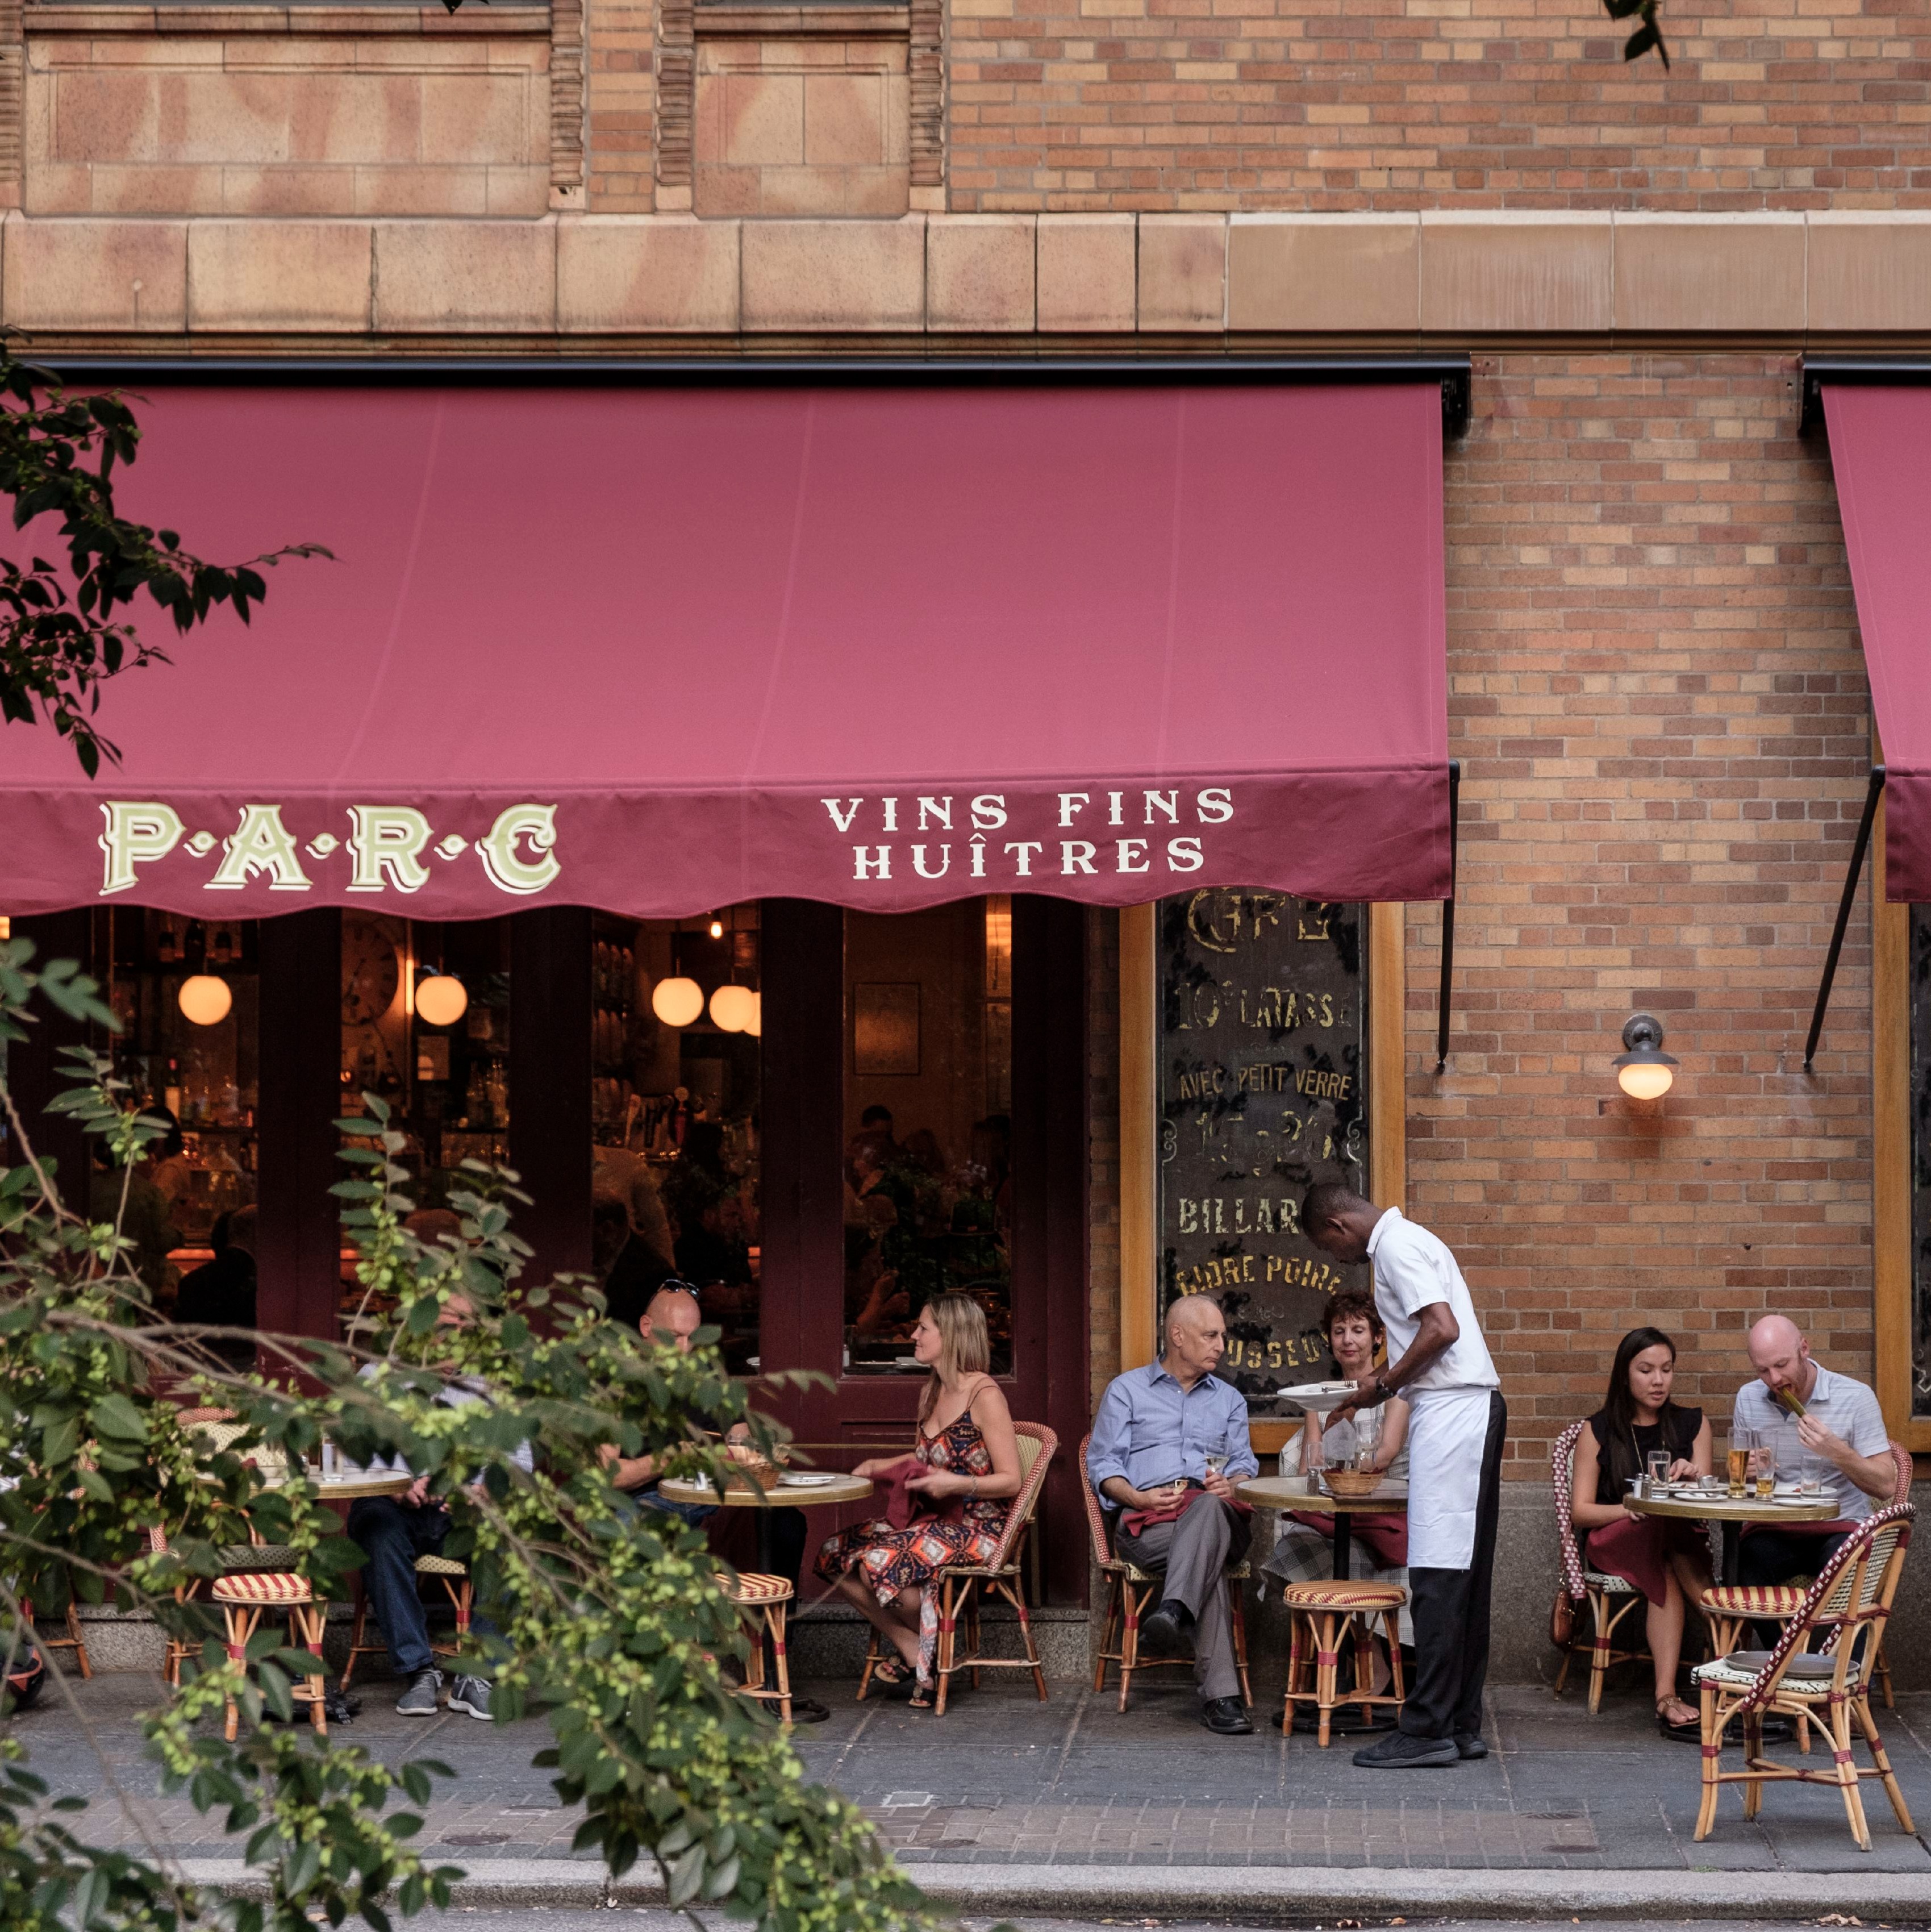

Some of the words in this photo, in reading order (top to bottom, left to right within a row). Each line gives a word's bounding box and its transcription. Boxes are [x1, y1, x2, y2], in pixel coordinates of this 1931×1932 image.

[820, 794, 1008, 832] VINS
[1057, 788, 1234, 827] FINS
[852, 832, 1205, 880] HUÎTRES
[1179, 1068, 1224, 1100] AVEC
[1237, 1063, 1289, 1092] PETIT
[1295, 1068, 1353, 1101] VERRE
[1178, 1198, 1300, 1234] BILLAR
[1176, 1255, 1255, 1296] CIDRE
[1227, 1331, 1329, 1369] USSEU
